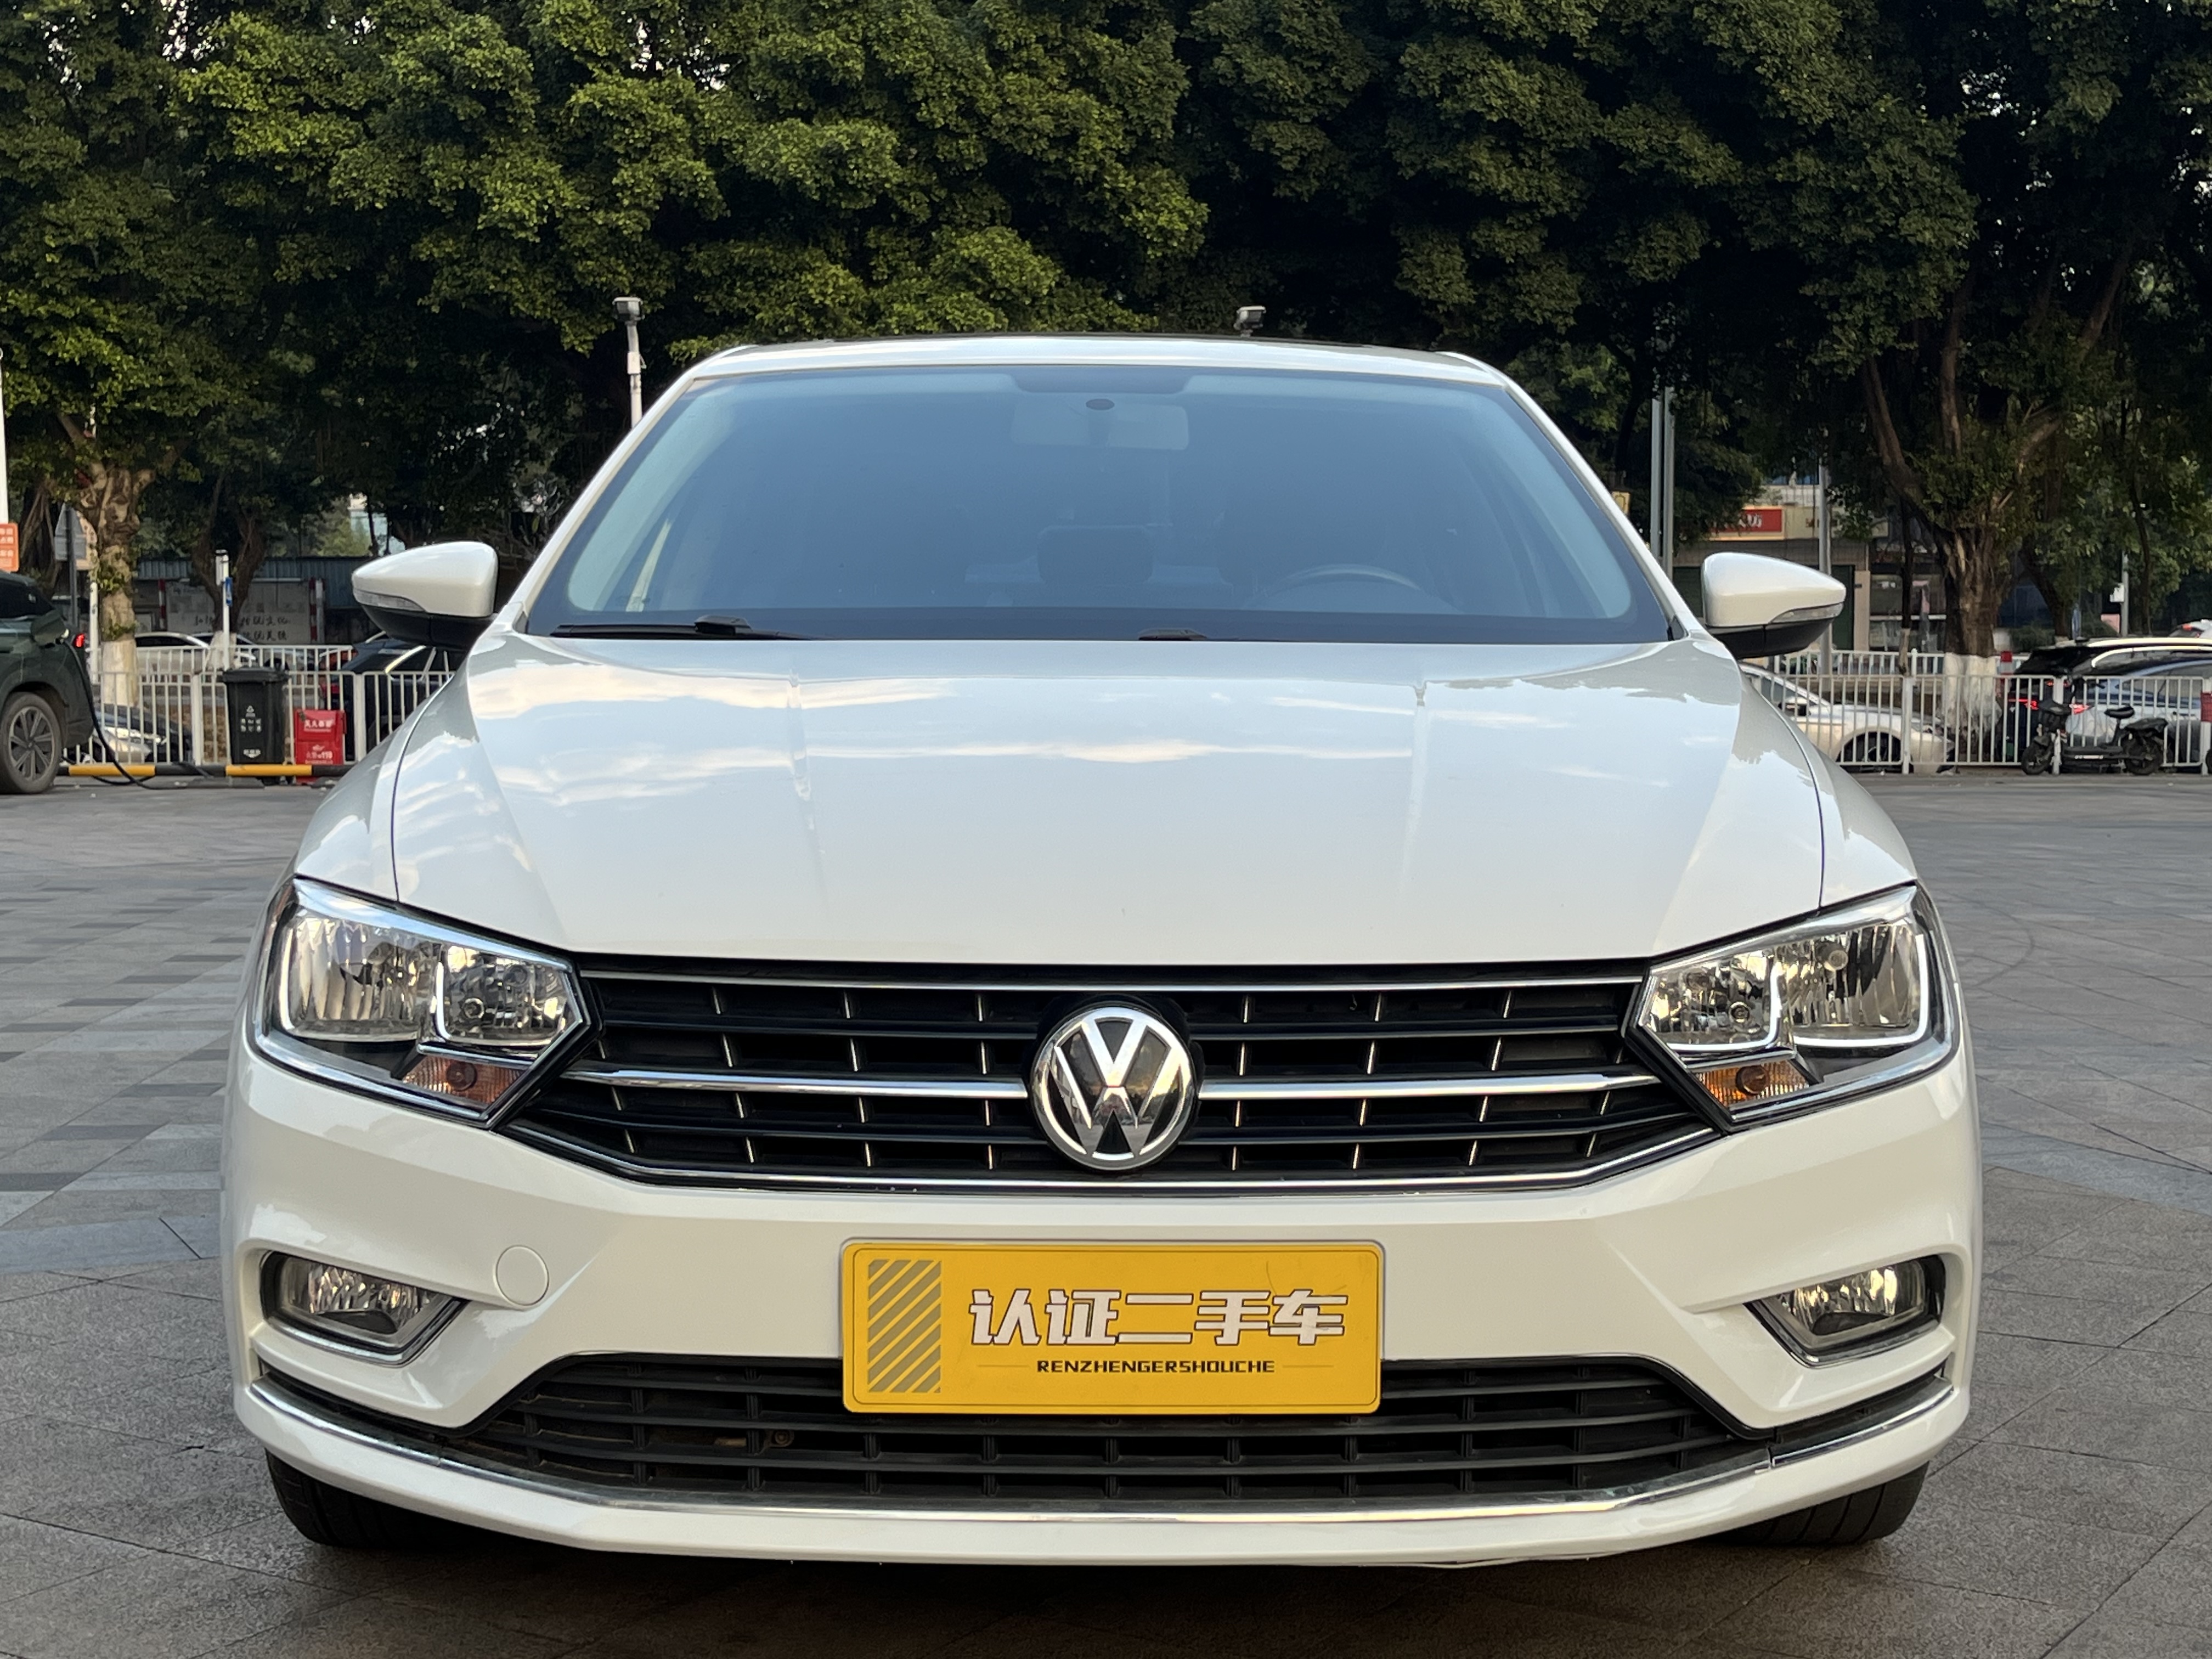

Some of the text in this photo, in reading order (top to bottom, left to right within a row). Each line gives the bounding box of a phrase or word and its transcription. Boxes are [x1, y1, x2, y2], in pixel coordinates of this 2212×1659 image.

[968, 1288, 1348, 1346] 认证二手车
[1037, 1361, 1274, 1373] RENZHENGERSHOUCHE
